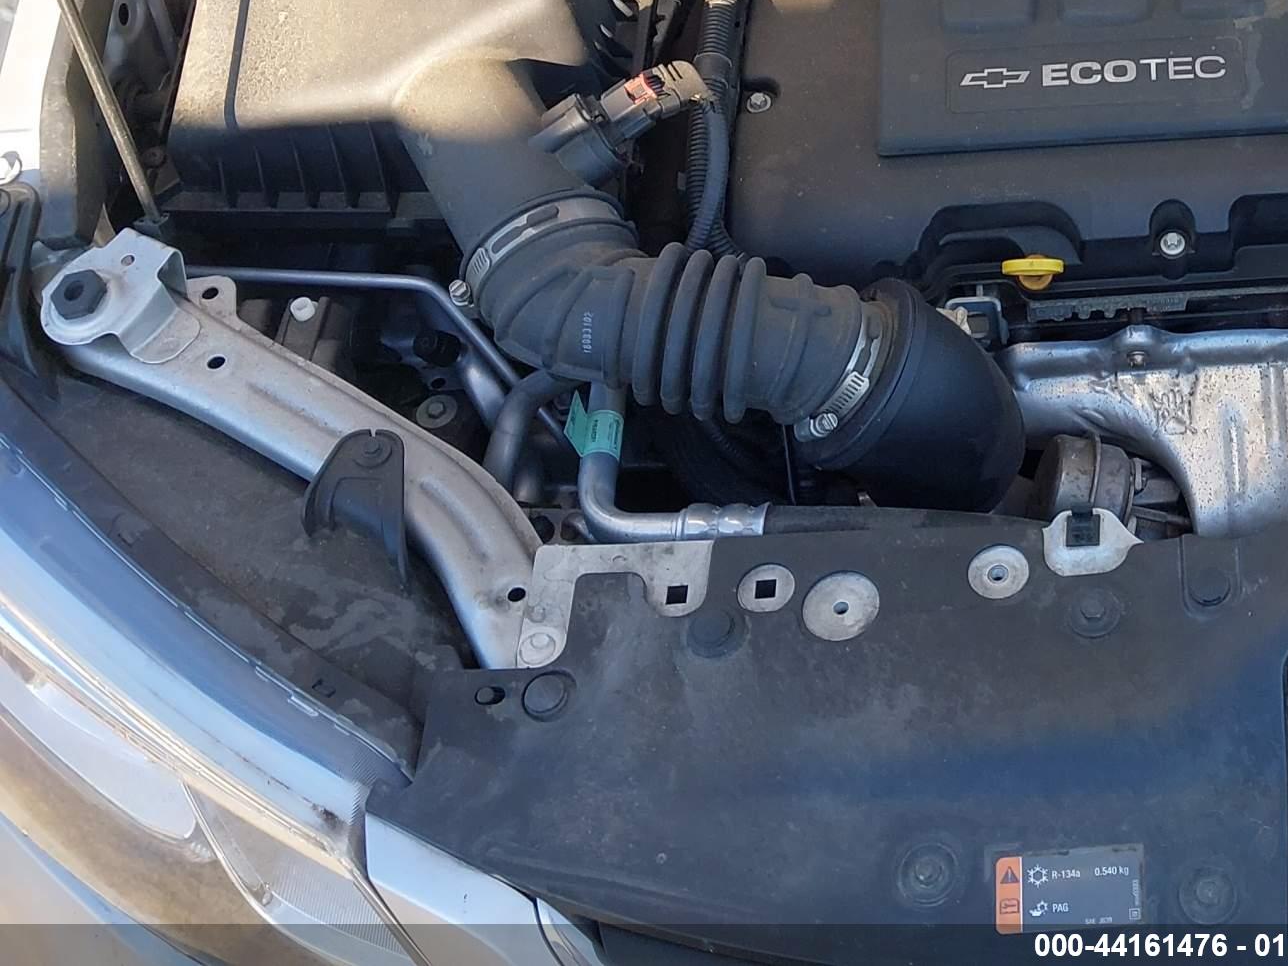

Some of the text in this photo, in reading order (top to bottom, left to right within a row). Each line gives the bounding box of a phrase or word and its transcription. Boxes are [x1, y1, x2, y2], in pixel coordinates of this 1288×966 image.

[1042, 55, 1226, 86] ECOTEC
[1051, 865, 1129, 879] R-134a 0.540 kg
[1052, 902, 1069, 913] PAG
